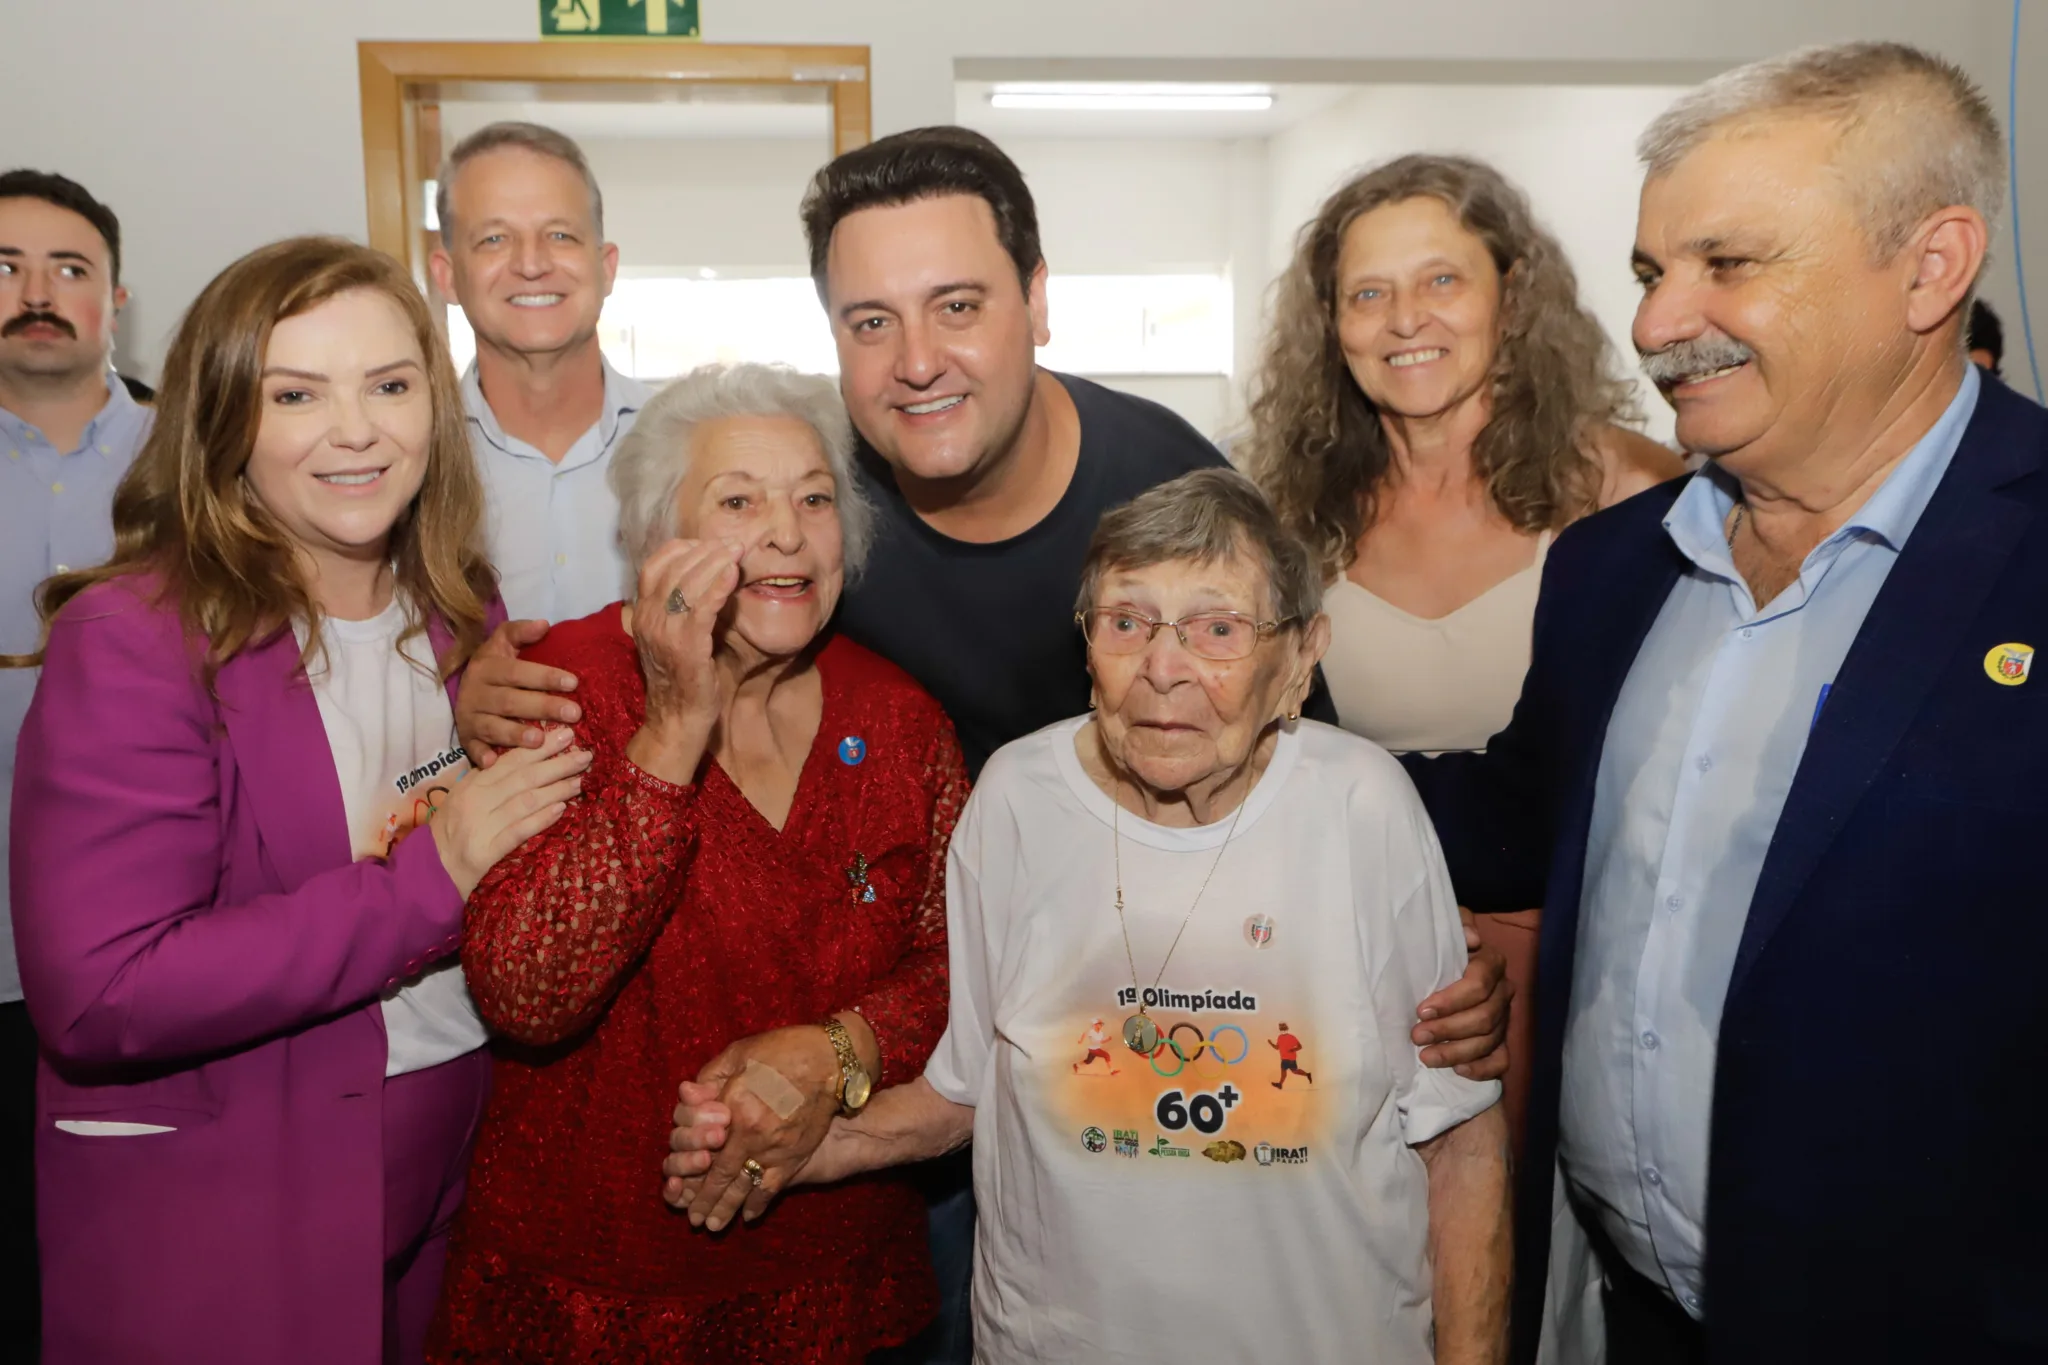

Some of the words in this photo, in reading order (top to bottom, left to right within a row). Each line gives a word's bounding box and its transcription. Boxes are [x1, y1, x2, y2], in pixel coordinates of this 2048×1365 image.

[409, 747, 467, 787] Ompíada
[1117, 987, 1137, 1006] 1ª
[1142, 988, 1256, 1012] Olimpíada
[1276, 1146, 1308, 1159] IRATI
